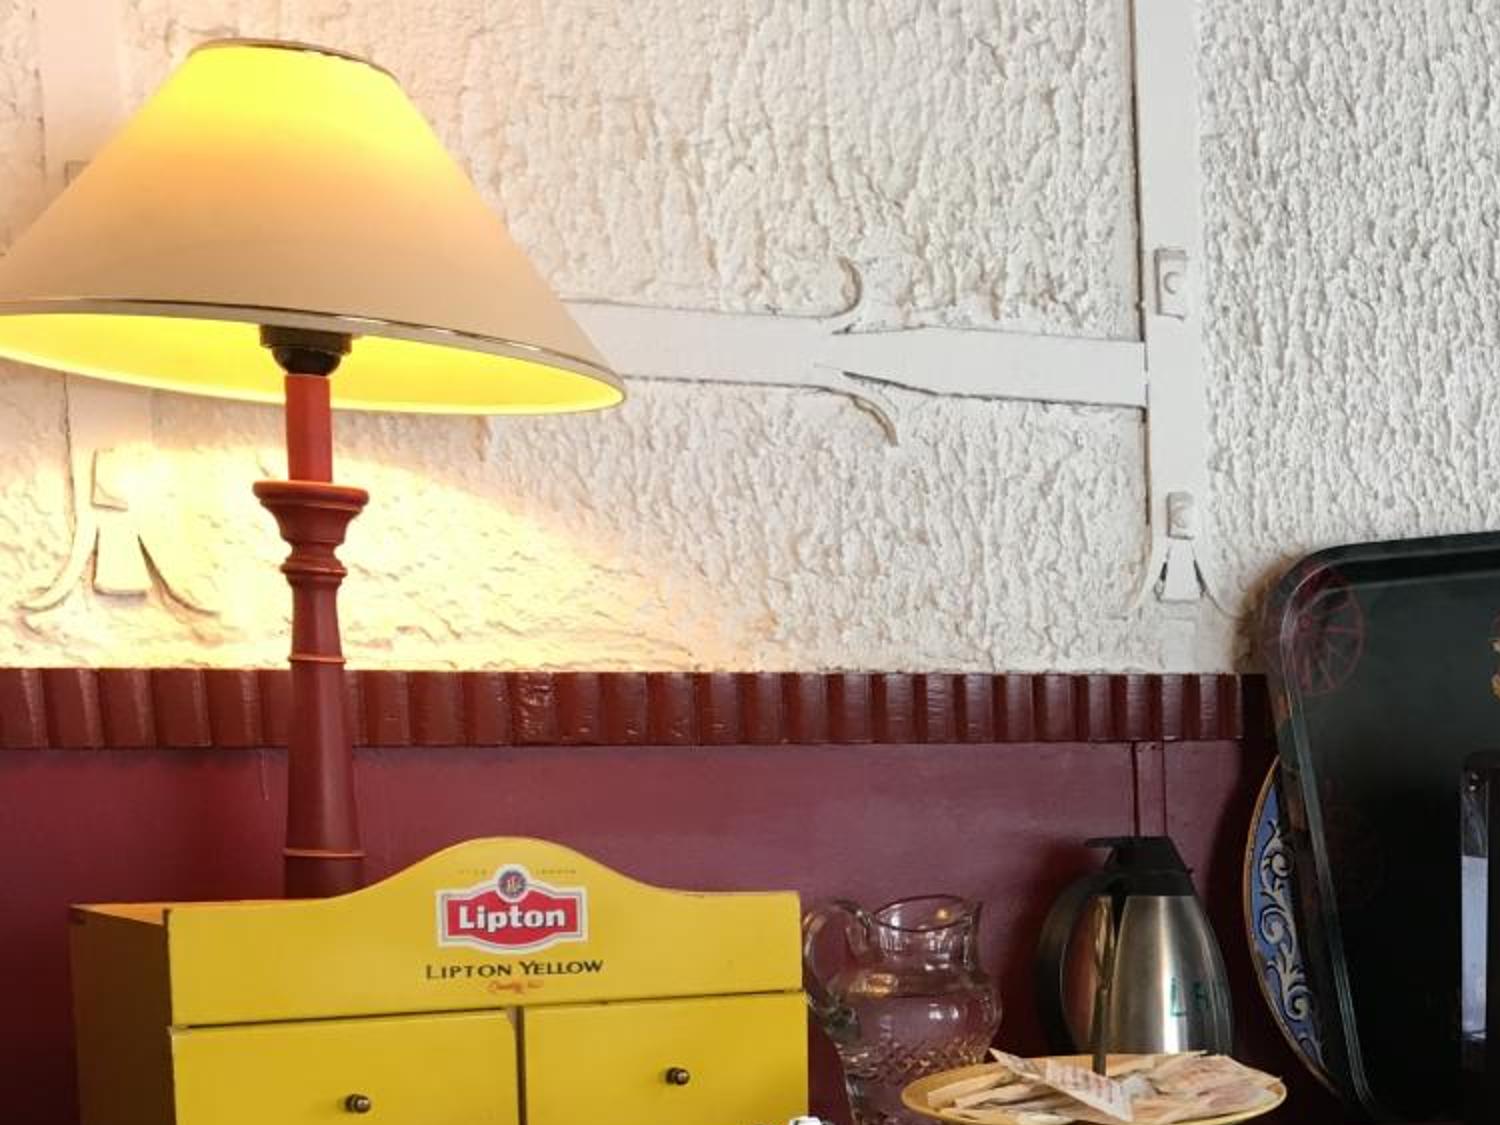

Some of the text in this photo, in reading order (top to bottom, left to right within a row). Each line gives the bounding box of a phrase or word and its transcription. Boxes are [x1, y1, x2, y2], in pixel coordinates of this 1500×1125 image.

[458, 904, 566, 933] Lipton
[426, 960, 603, 980] LIPTON YELLOW
